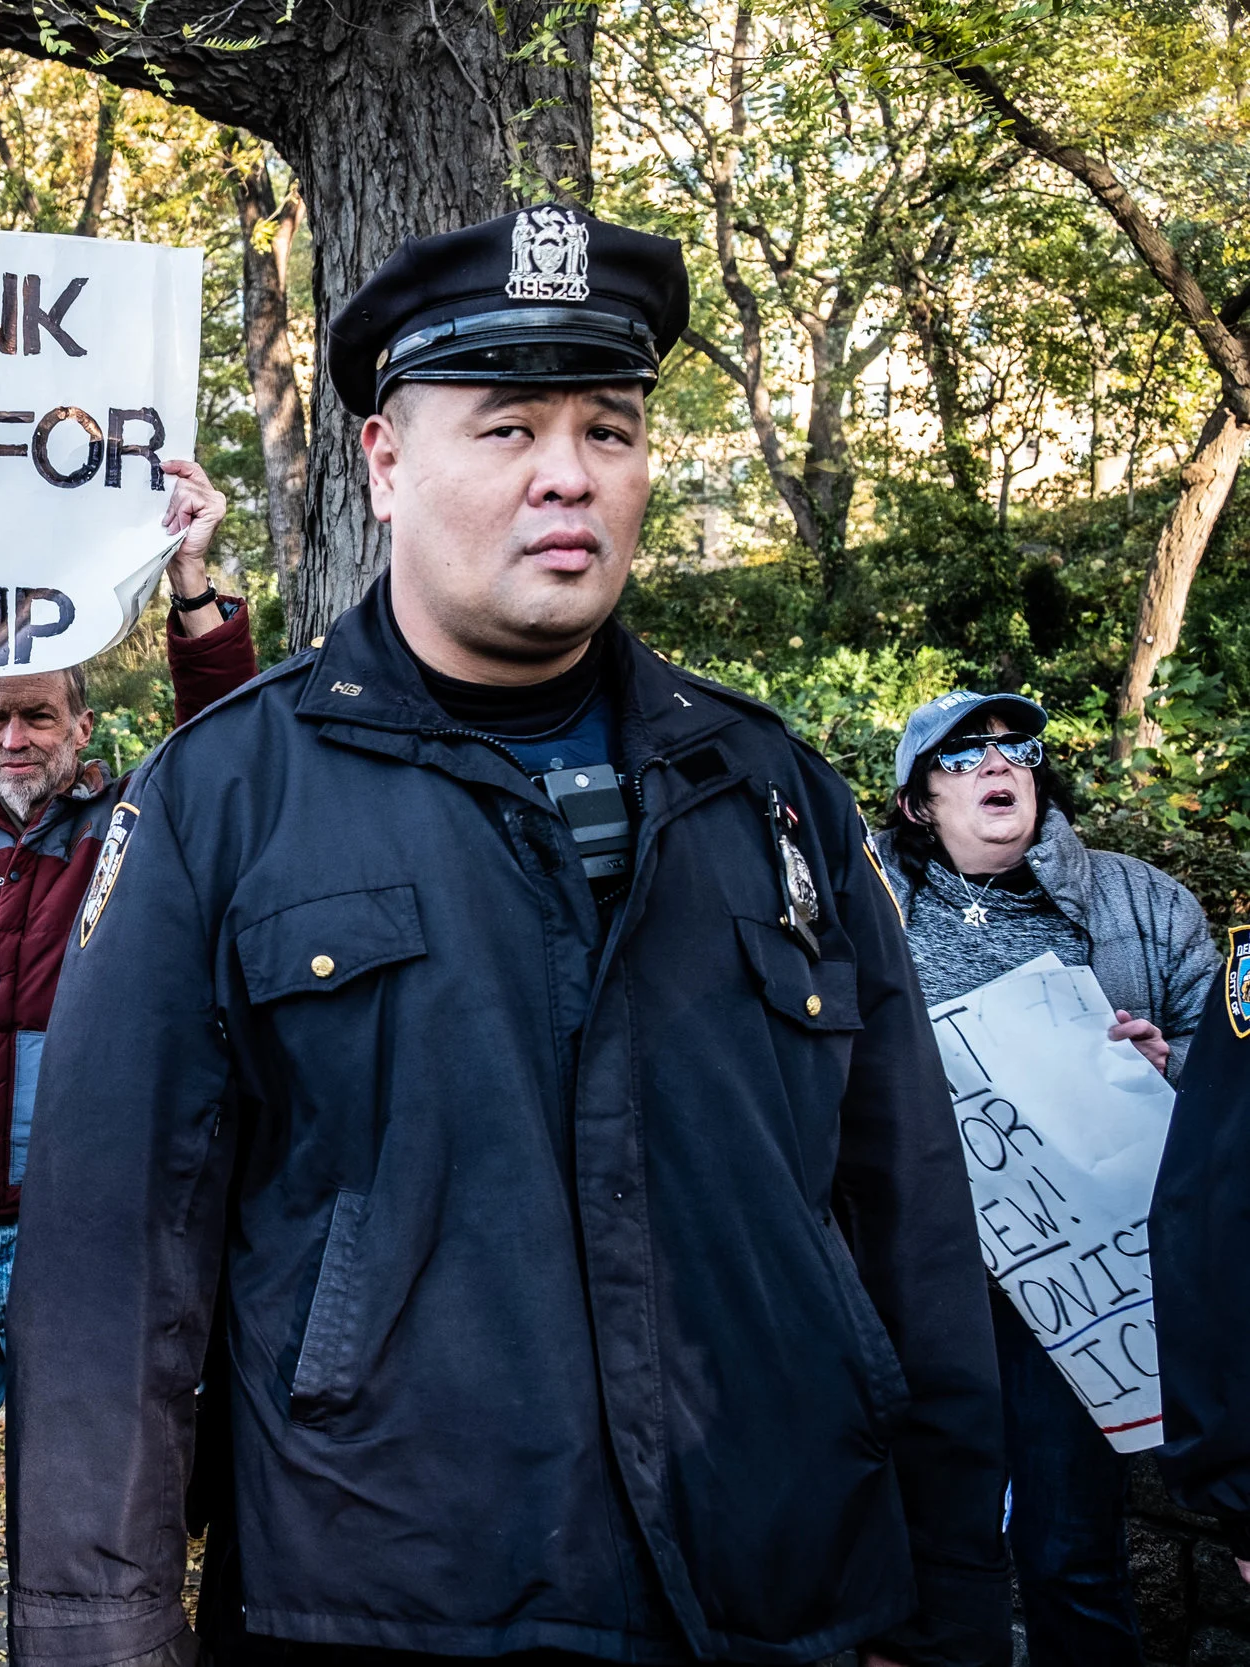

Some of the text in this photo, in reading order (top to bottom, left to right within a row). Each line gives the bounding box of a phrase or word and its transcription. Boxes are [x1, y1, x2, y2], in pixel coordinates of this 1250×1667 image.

[513, 279, 583, 301] 19524
[1229, 971, 1241, 1016] CITY OF
[960, 1098, 1044, 1173] OR
[1019, 1220, 1152, 1335] ONIS
